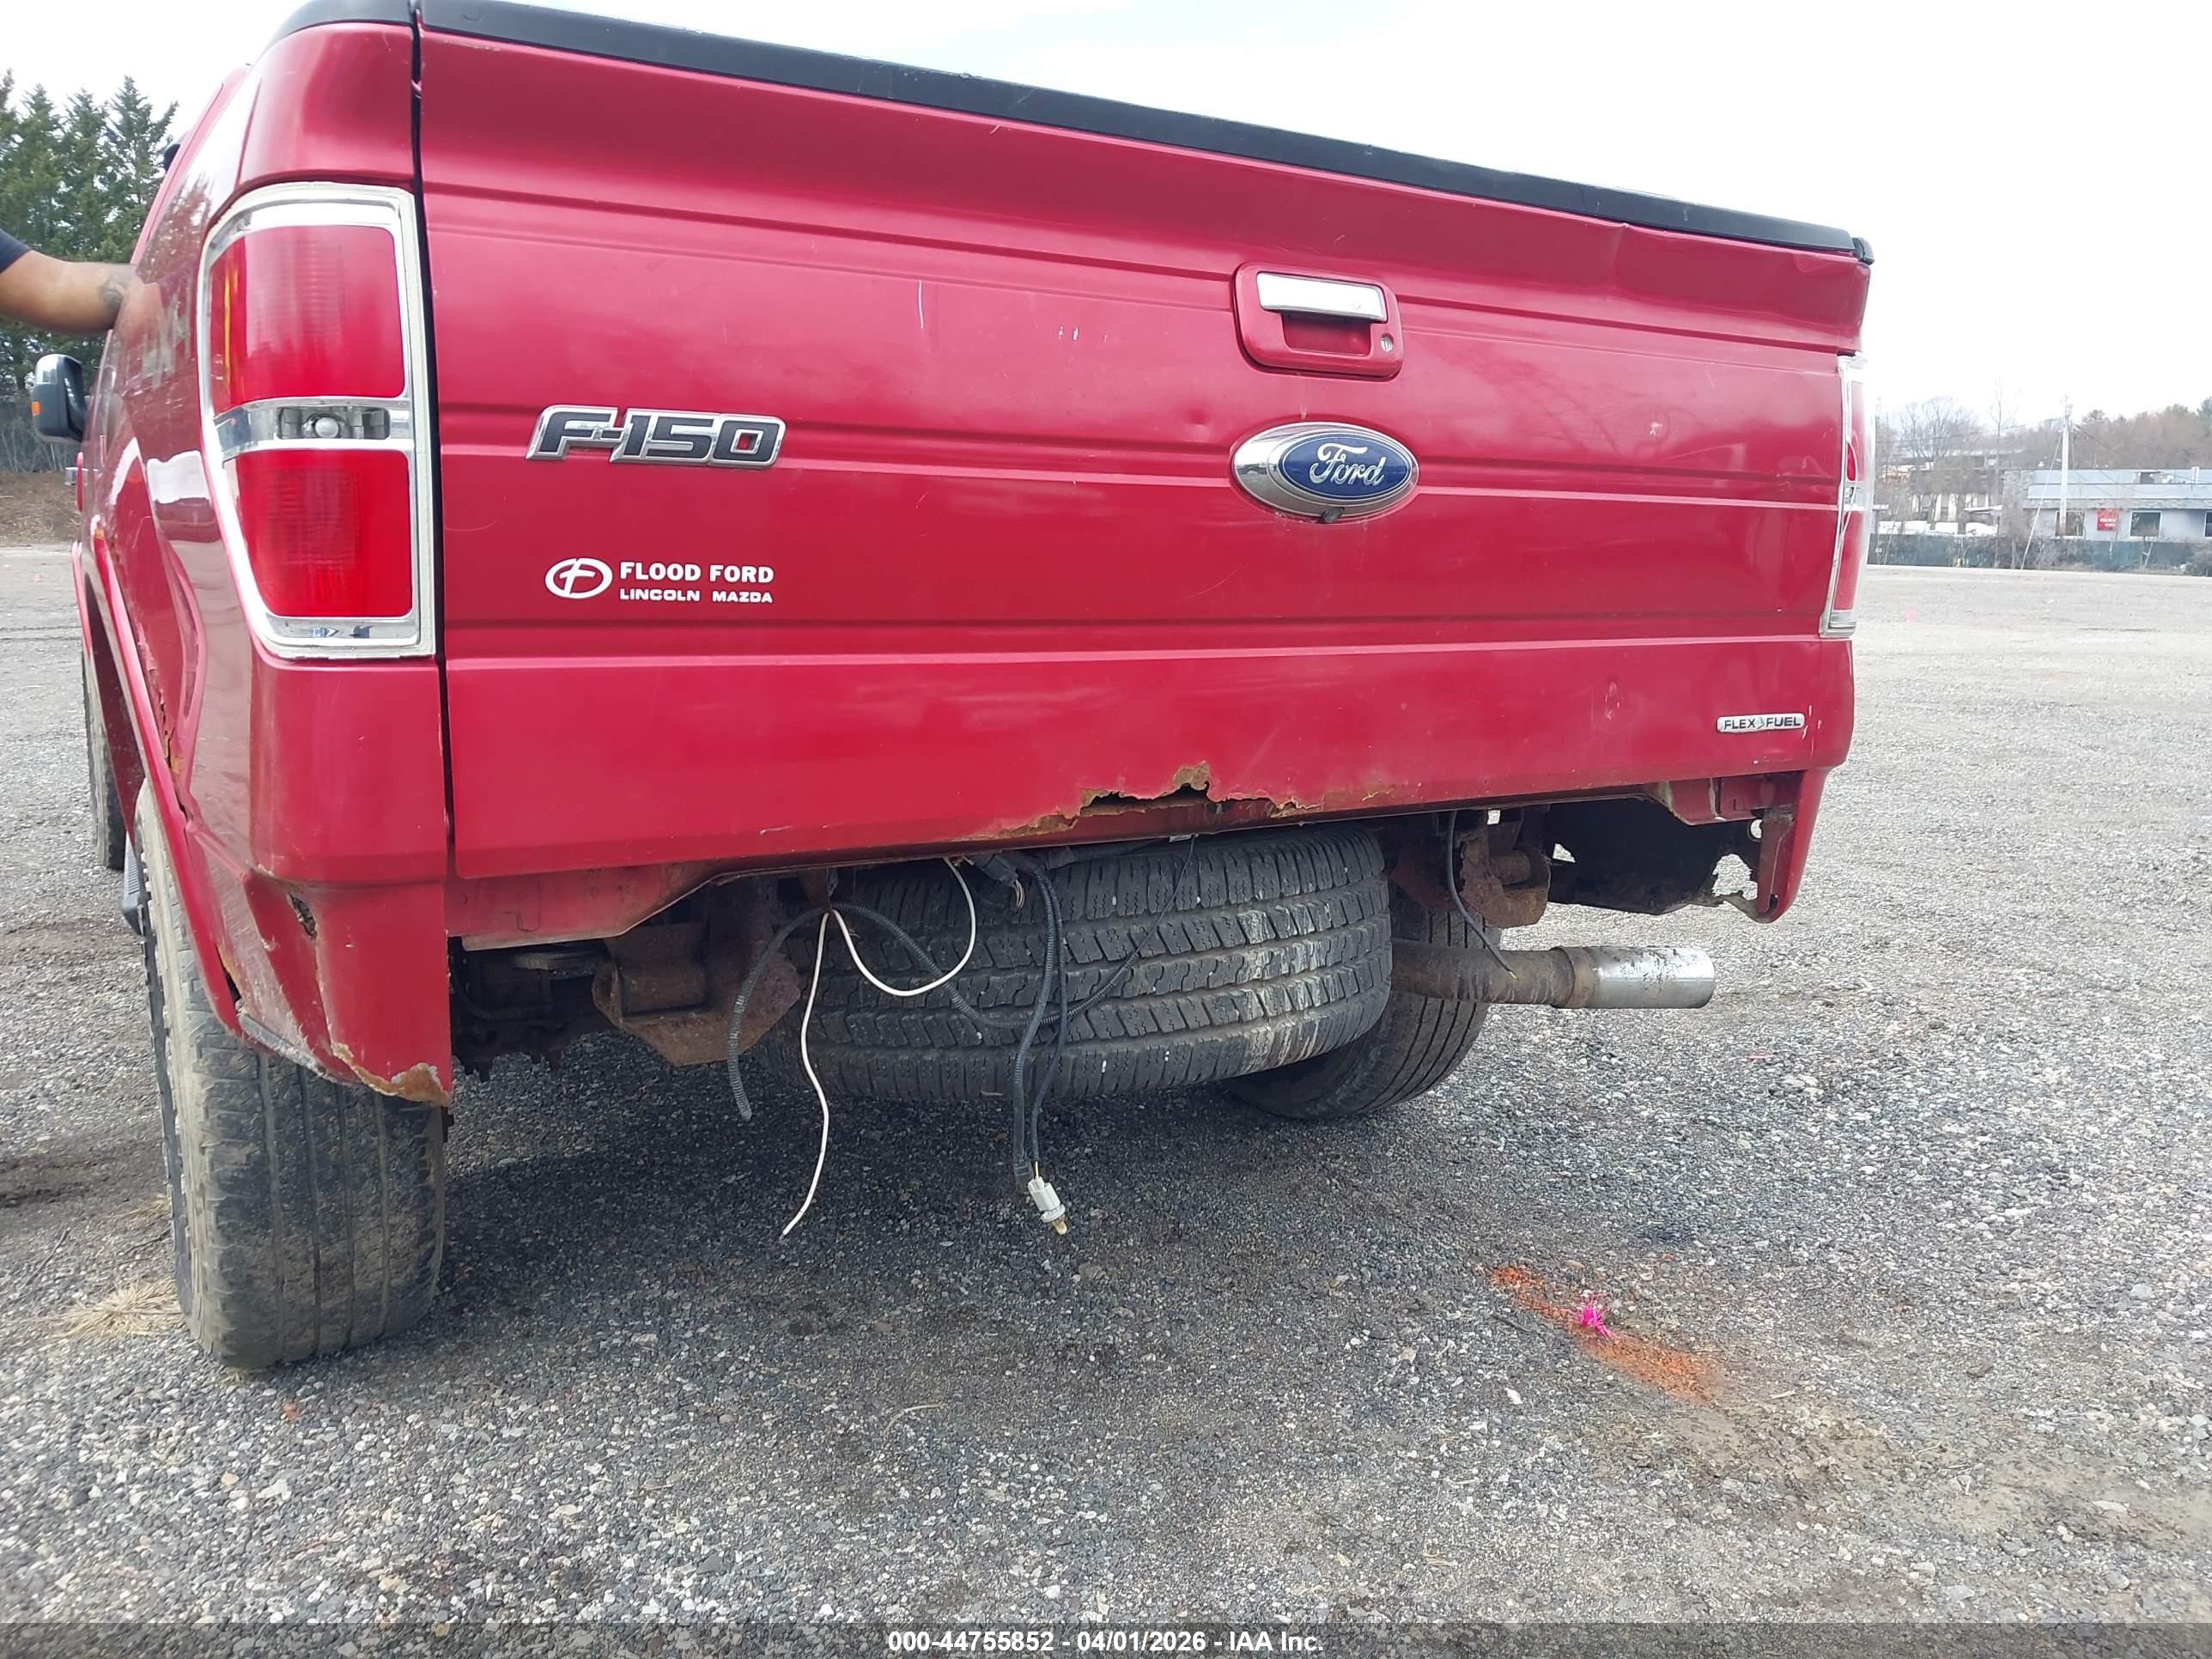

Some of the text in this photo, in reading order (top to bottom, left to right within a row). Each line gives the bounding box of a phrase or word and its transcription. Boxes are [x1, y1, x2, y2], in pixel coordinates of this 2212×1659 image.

[526, 404, 786, 468] F-150
[1310, 442, 1387, 486] Ford
[620, 562, 774, 583] FLOOD FORD
[620, 588, 773, 603] LINCOLN MAZDA
[1723, 716, 1802, 730] FLEX FUEL
